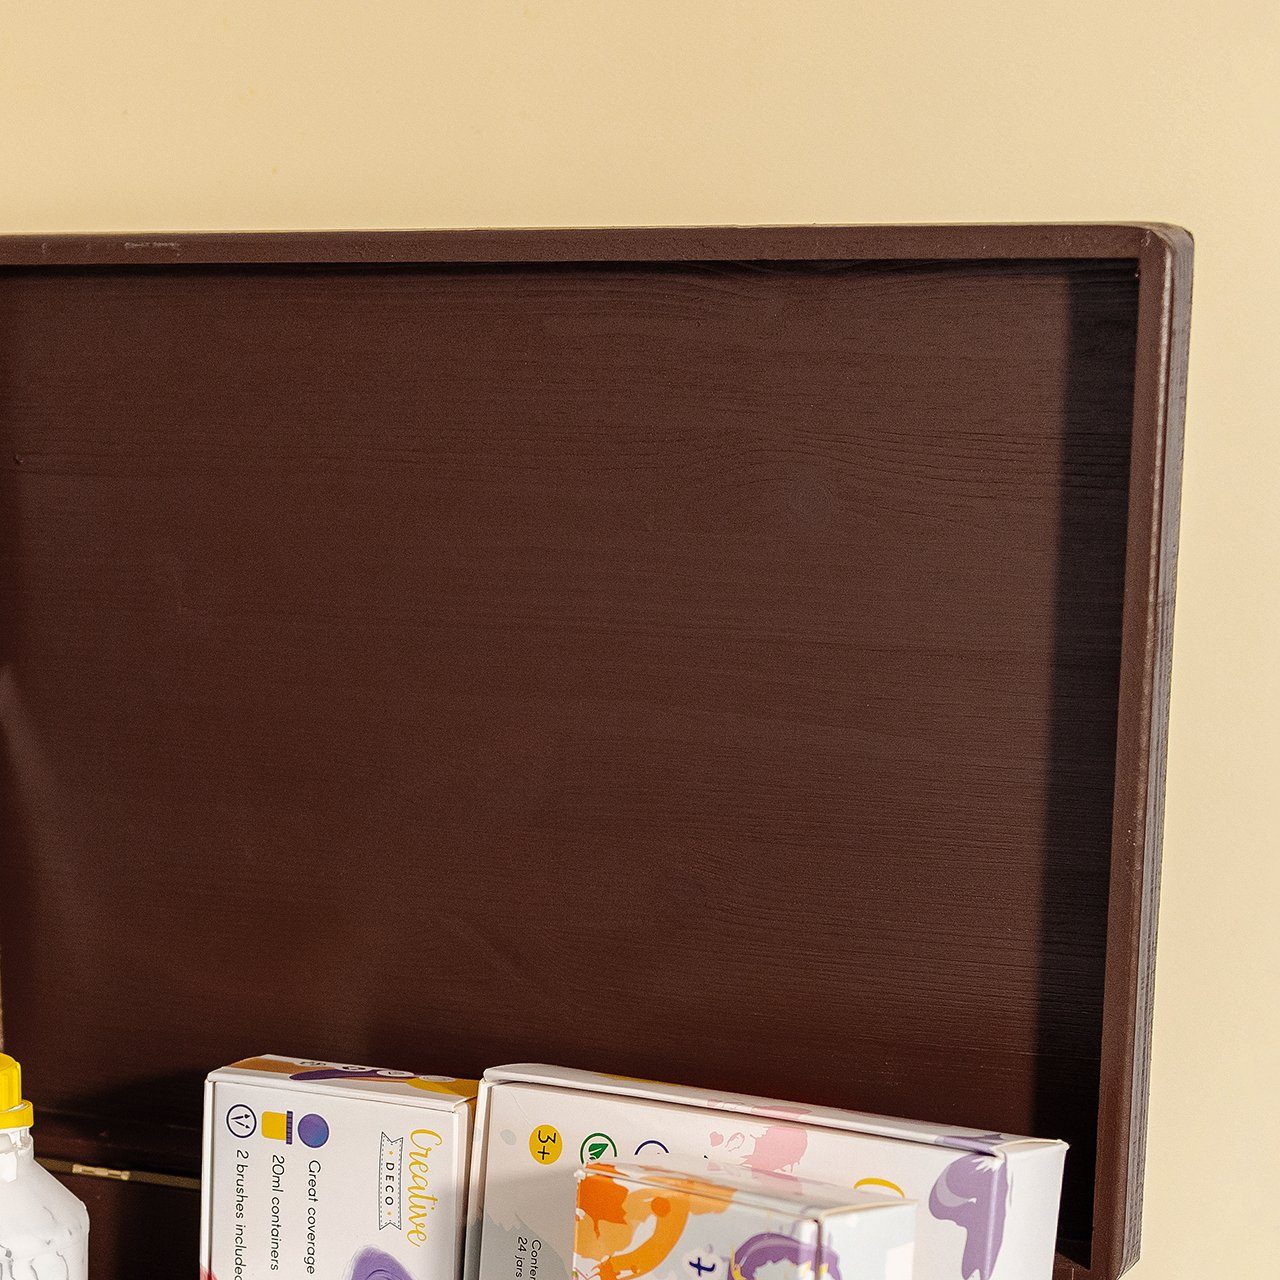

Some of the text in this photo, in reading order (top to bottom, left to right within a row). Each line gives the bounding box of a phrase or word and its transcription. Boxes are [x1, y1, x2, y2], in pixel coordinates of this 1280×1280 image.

[236, 1149, 249, 1160] 2
[537, 1130, 556, 1161] 3+
[235, 1164, 249, 1219] brushes
[385, 1162, 395, 1206] DECO
[407, 1129, 442, 1247] Creative
[270, 1155, 285, 1271] 20ml containers
[303, 1159, 322, 1275] Great coverage
[514, 1252, 526, 1278] jars
[517, 1236, 528, 1252] 24
